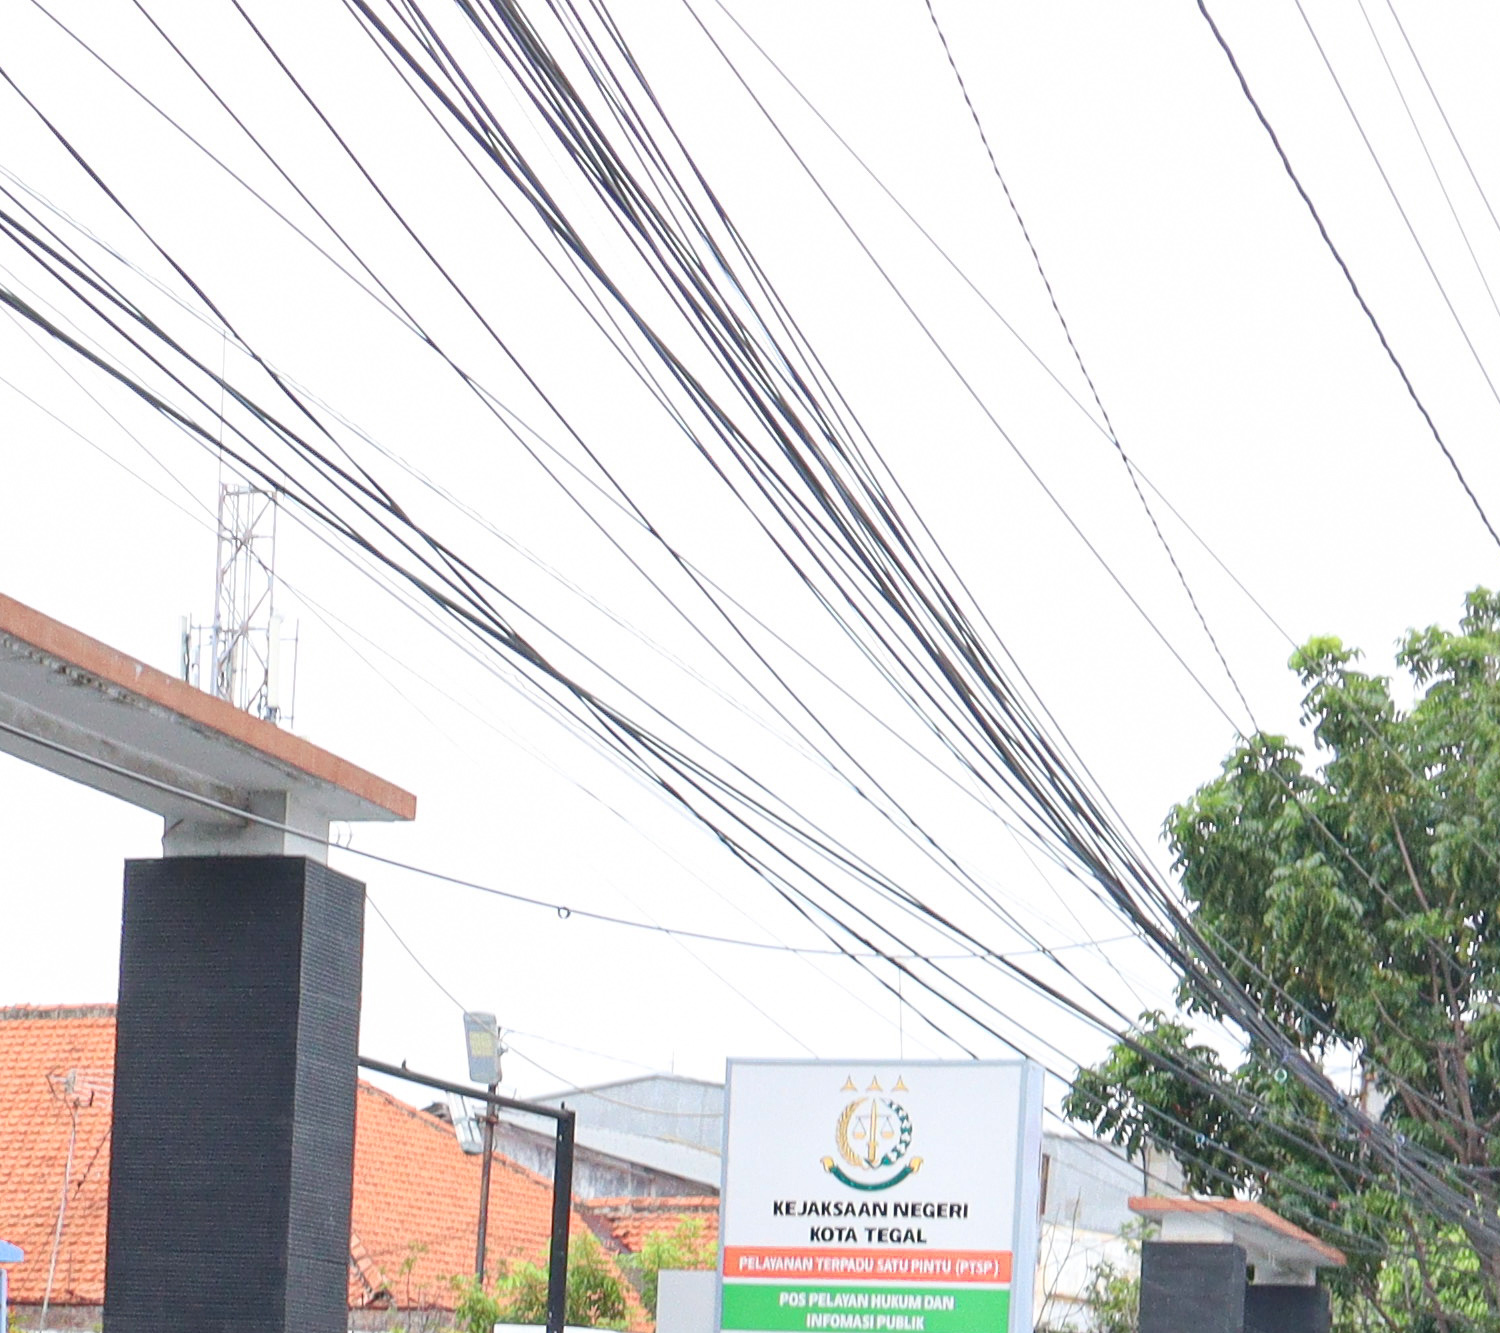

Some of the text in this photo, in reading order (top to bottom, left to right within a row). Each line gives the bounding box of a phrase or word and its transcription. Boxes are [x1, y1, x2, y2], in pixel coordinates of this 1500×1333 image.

[773, 1200, 969, 1219] KEJAKSAAN NEGERI
[810, 1227, 927, 1244] KOTA TEGAL
[739, 1255, 814, 1272] PELAYANAN
[816, 1256, 874, 1272] TERPADU
[877, 1258, 909, 1273] SATU
[911, 1259, 951, 1274] PINTU
[779, 1292, 955, 1310] POS PELAYAN HUKUM DAN
[806, 1313, 925, 1331] INFOMASI PUBLIK
